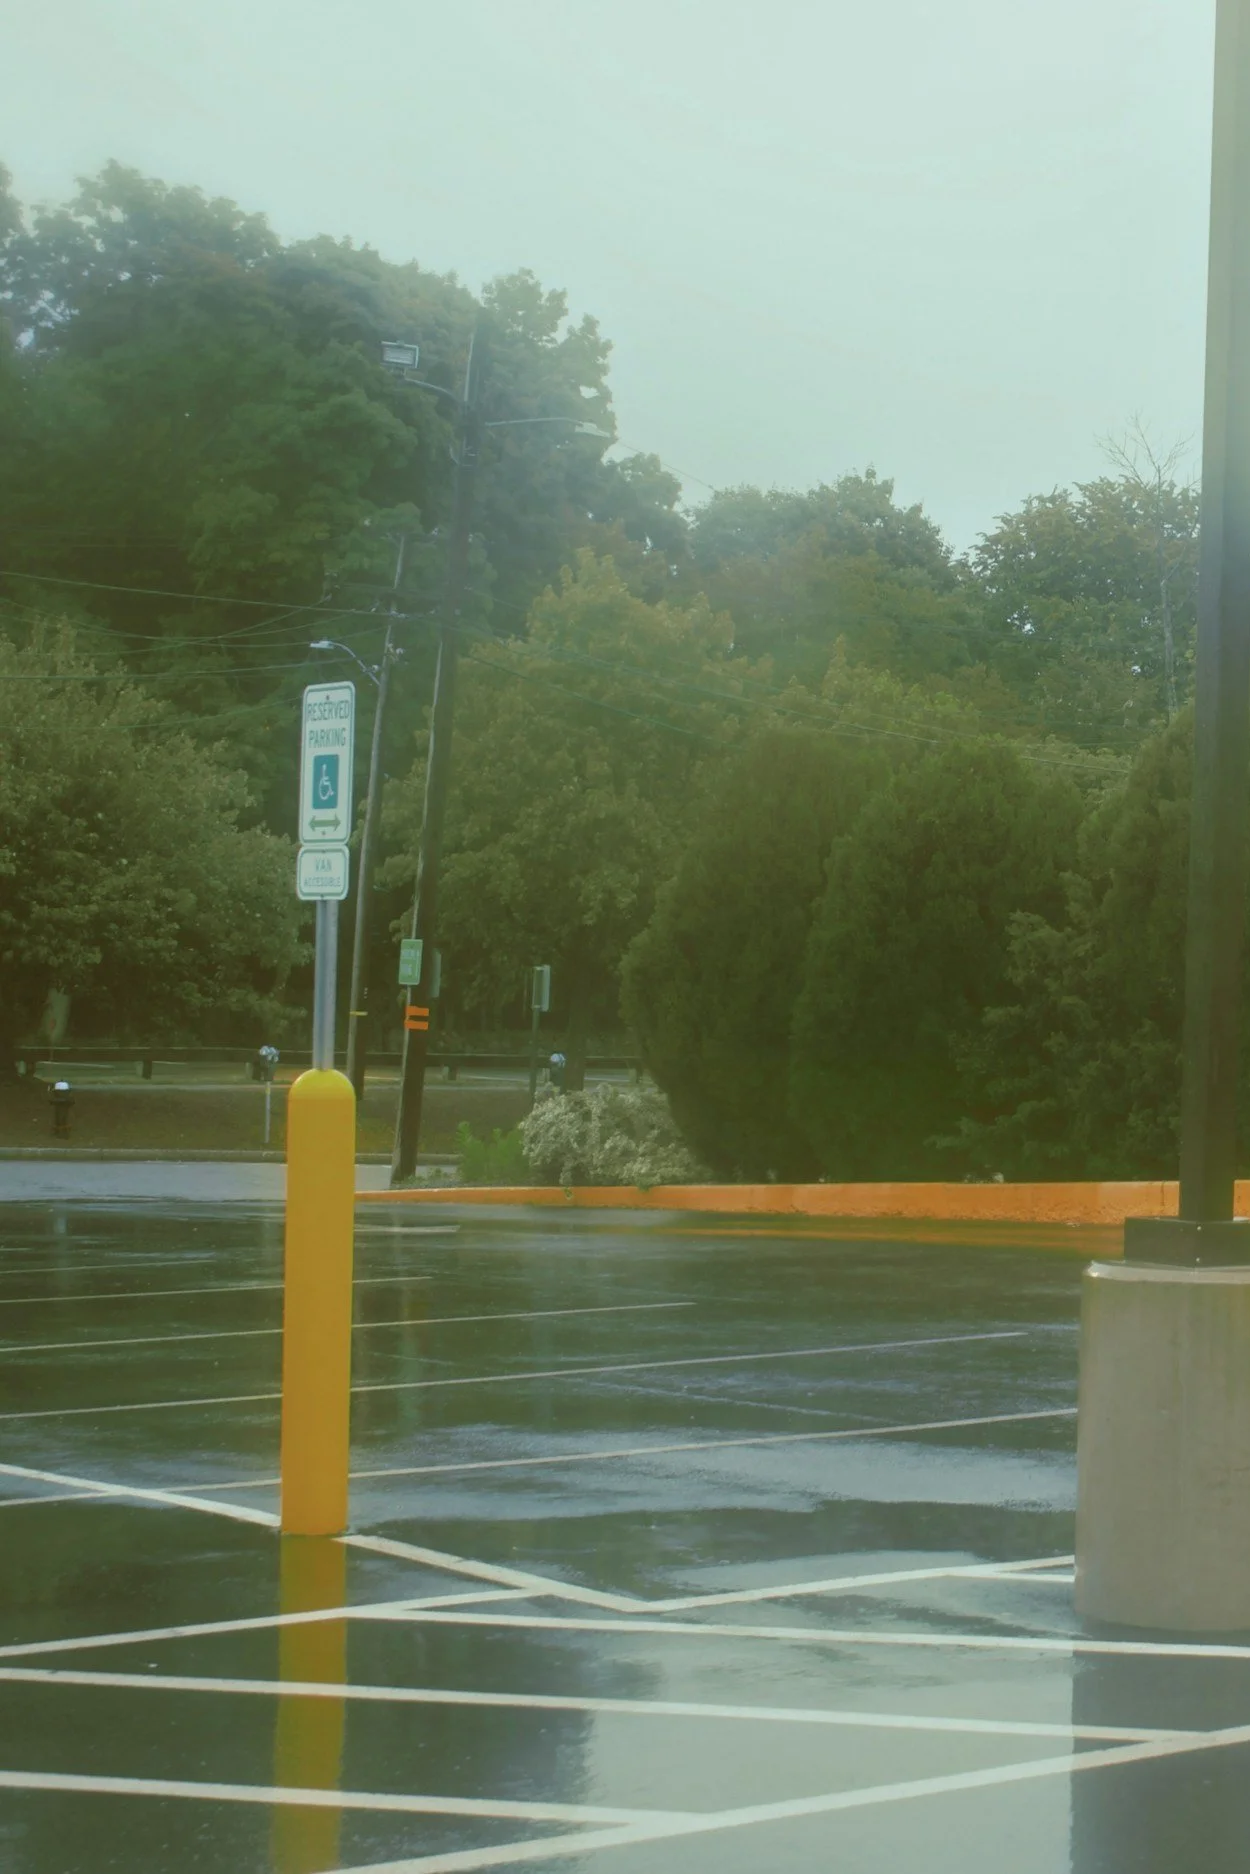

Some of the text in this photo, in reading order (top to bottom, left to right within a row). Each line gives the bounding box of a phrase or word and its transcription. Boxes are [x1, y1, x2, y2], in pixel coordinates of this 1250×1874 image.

[307, 700, 350, 722] RESERVED
[308, 727, 346, 749] PARKING
[315, 857, 332, 872] VAN
